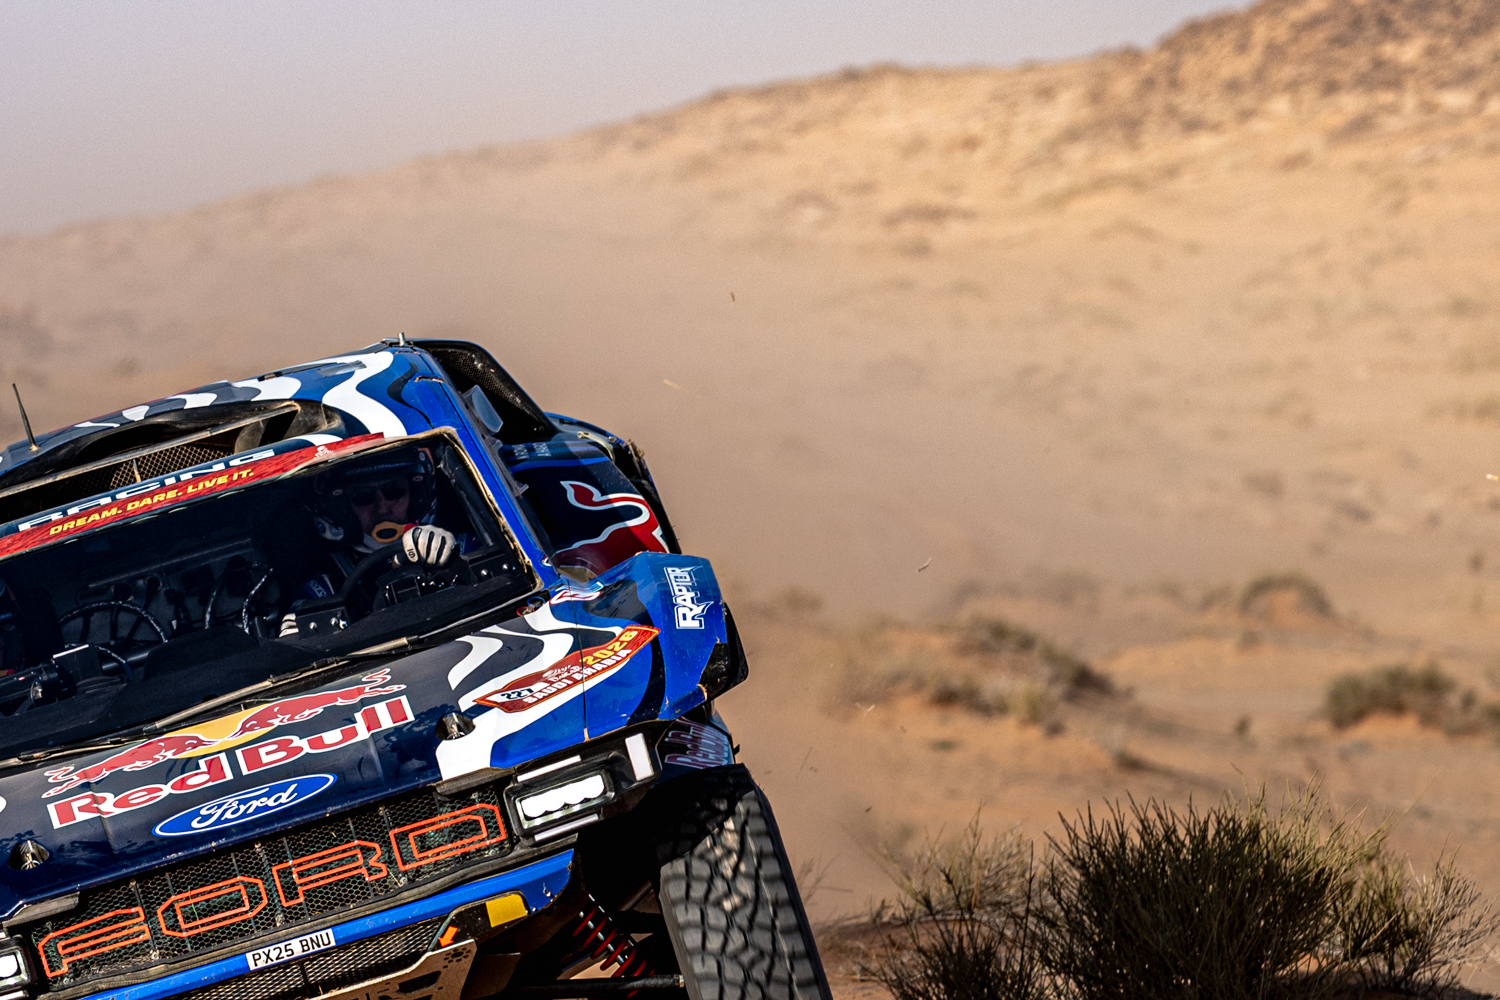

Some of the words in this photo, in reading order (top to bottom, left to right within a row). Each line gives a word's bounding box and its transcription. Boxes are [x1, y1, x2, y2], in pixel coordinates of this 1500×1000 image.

[49, 508, 122, 535] DREAM.
[126, 489, 183, 511] DARE.
[187, 474, 230, 494] LIVE
[231, 468, 255, 482] IT.
[663, 565, 714, 629] RAPTOR
[579, 630, 638, 665] 2026
[500, 688, 534, 700] 227
[522, 676, 576, 704] SAUDI
[575, 649, 632, 681] ARABIA
[46, 751, 234, 830] Red
[235, 694, 415, 775] Bull
[190, 783, 299, 829] Ford
[38, 803, 508, 978] FORD
[252, 942, 294, 967] PX25
[299, 932, 331, 953] BNU
